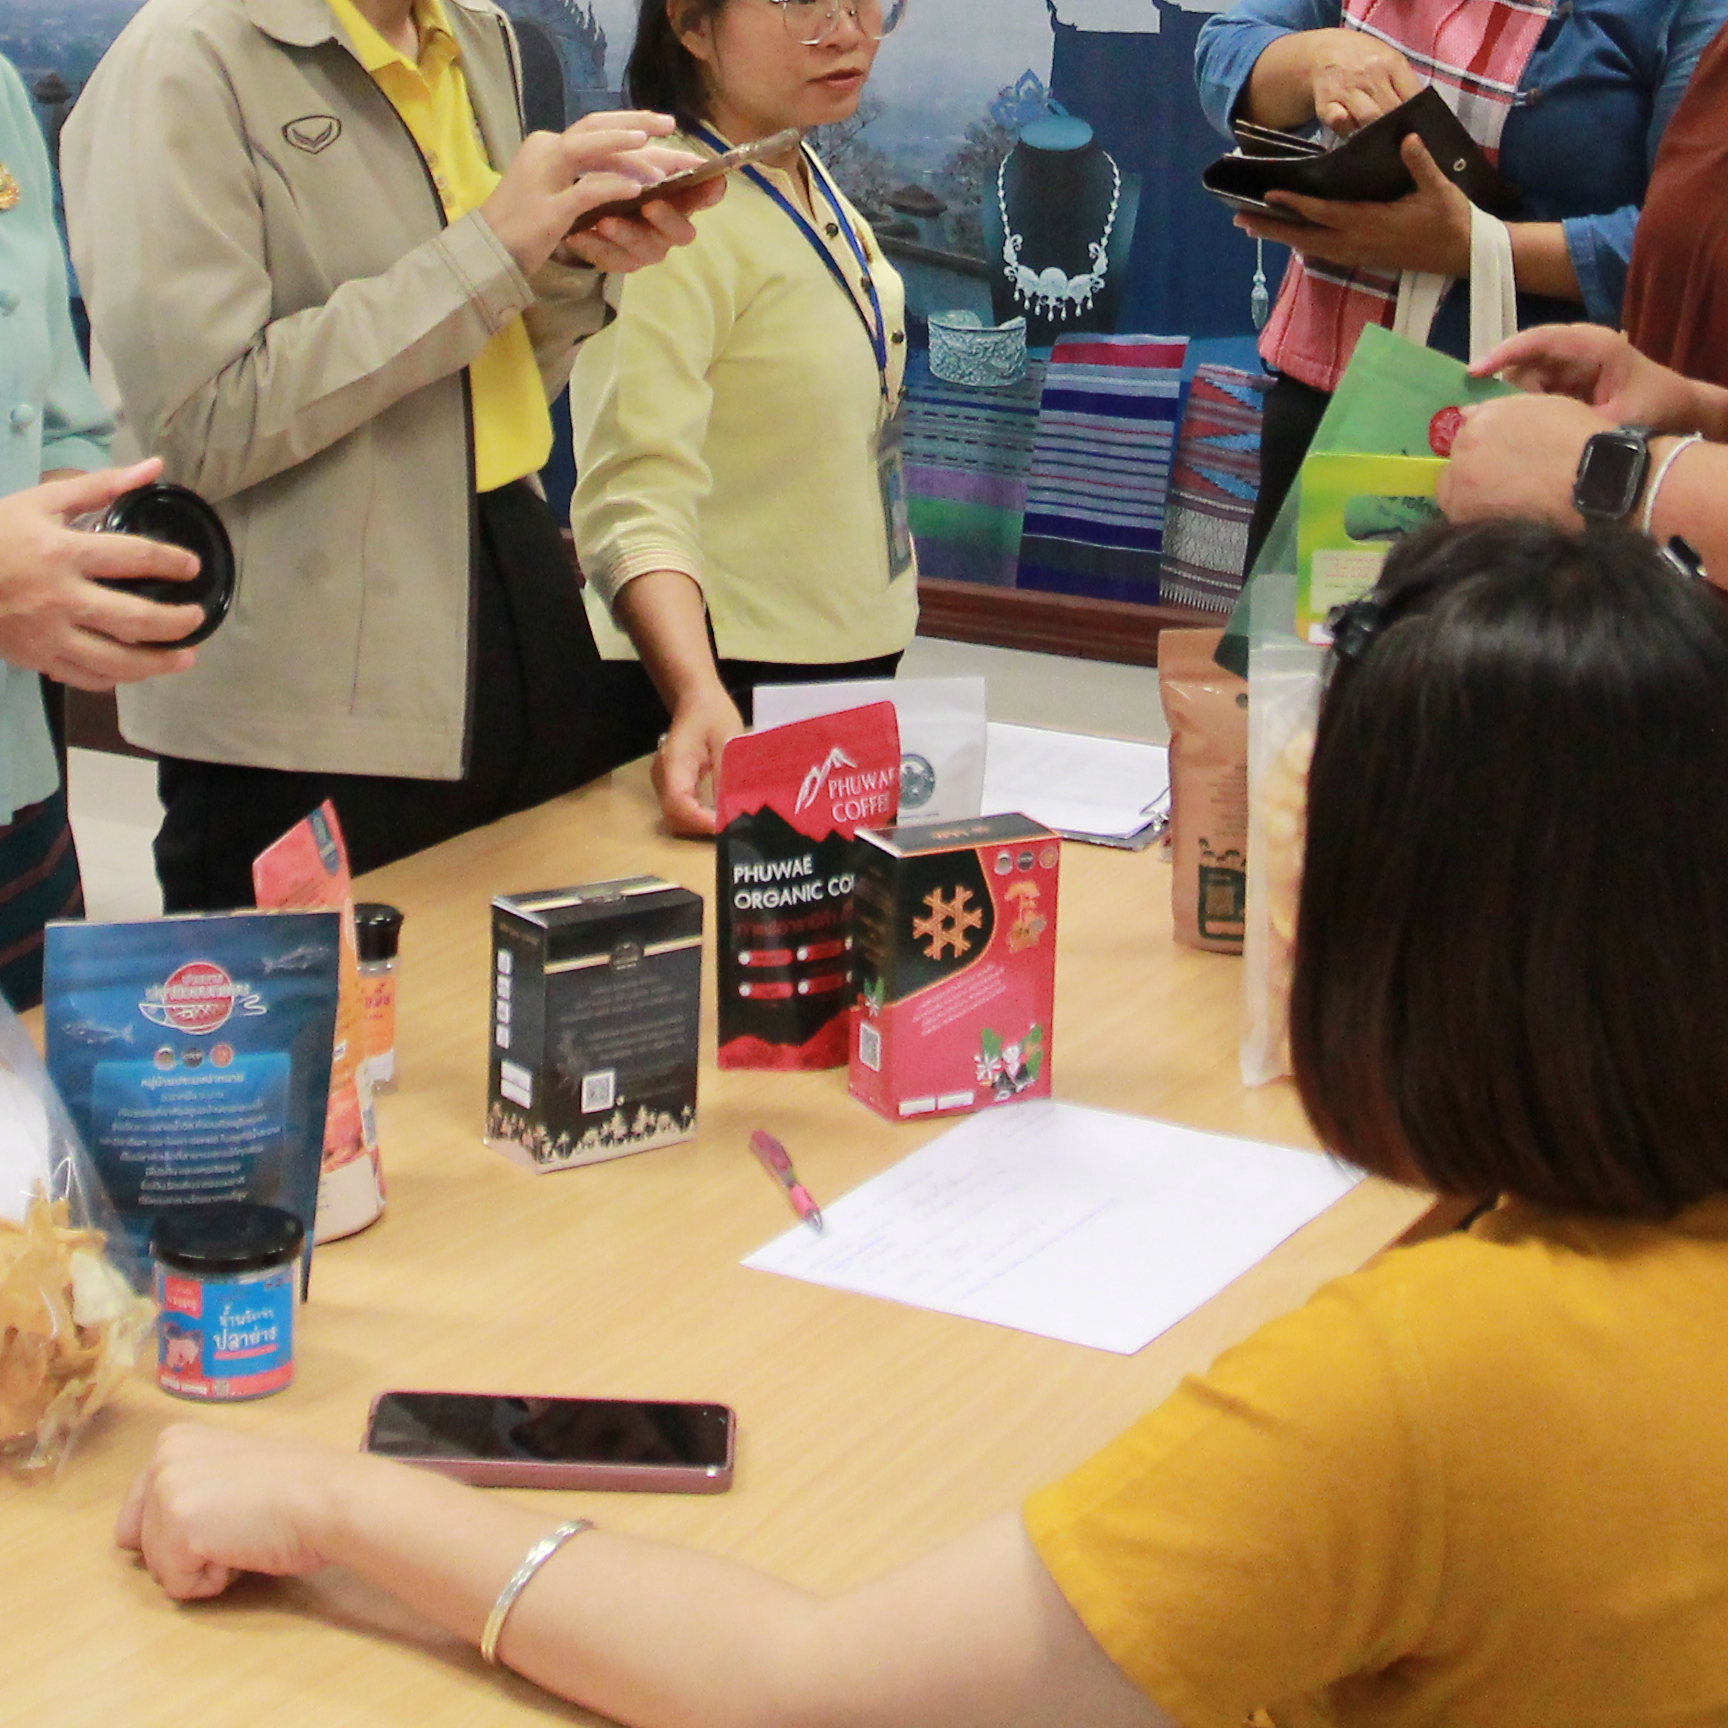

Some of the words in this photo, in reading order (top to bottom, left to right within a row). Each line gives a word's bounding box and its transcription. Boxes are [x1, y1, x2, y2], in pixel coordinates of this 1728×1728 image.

[733, 855, 814, 885] PHUWAE
[733, 880, 825, 910] ORGANIC
[828, 873, 855, 897] CO
